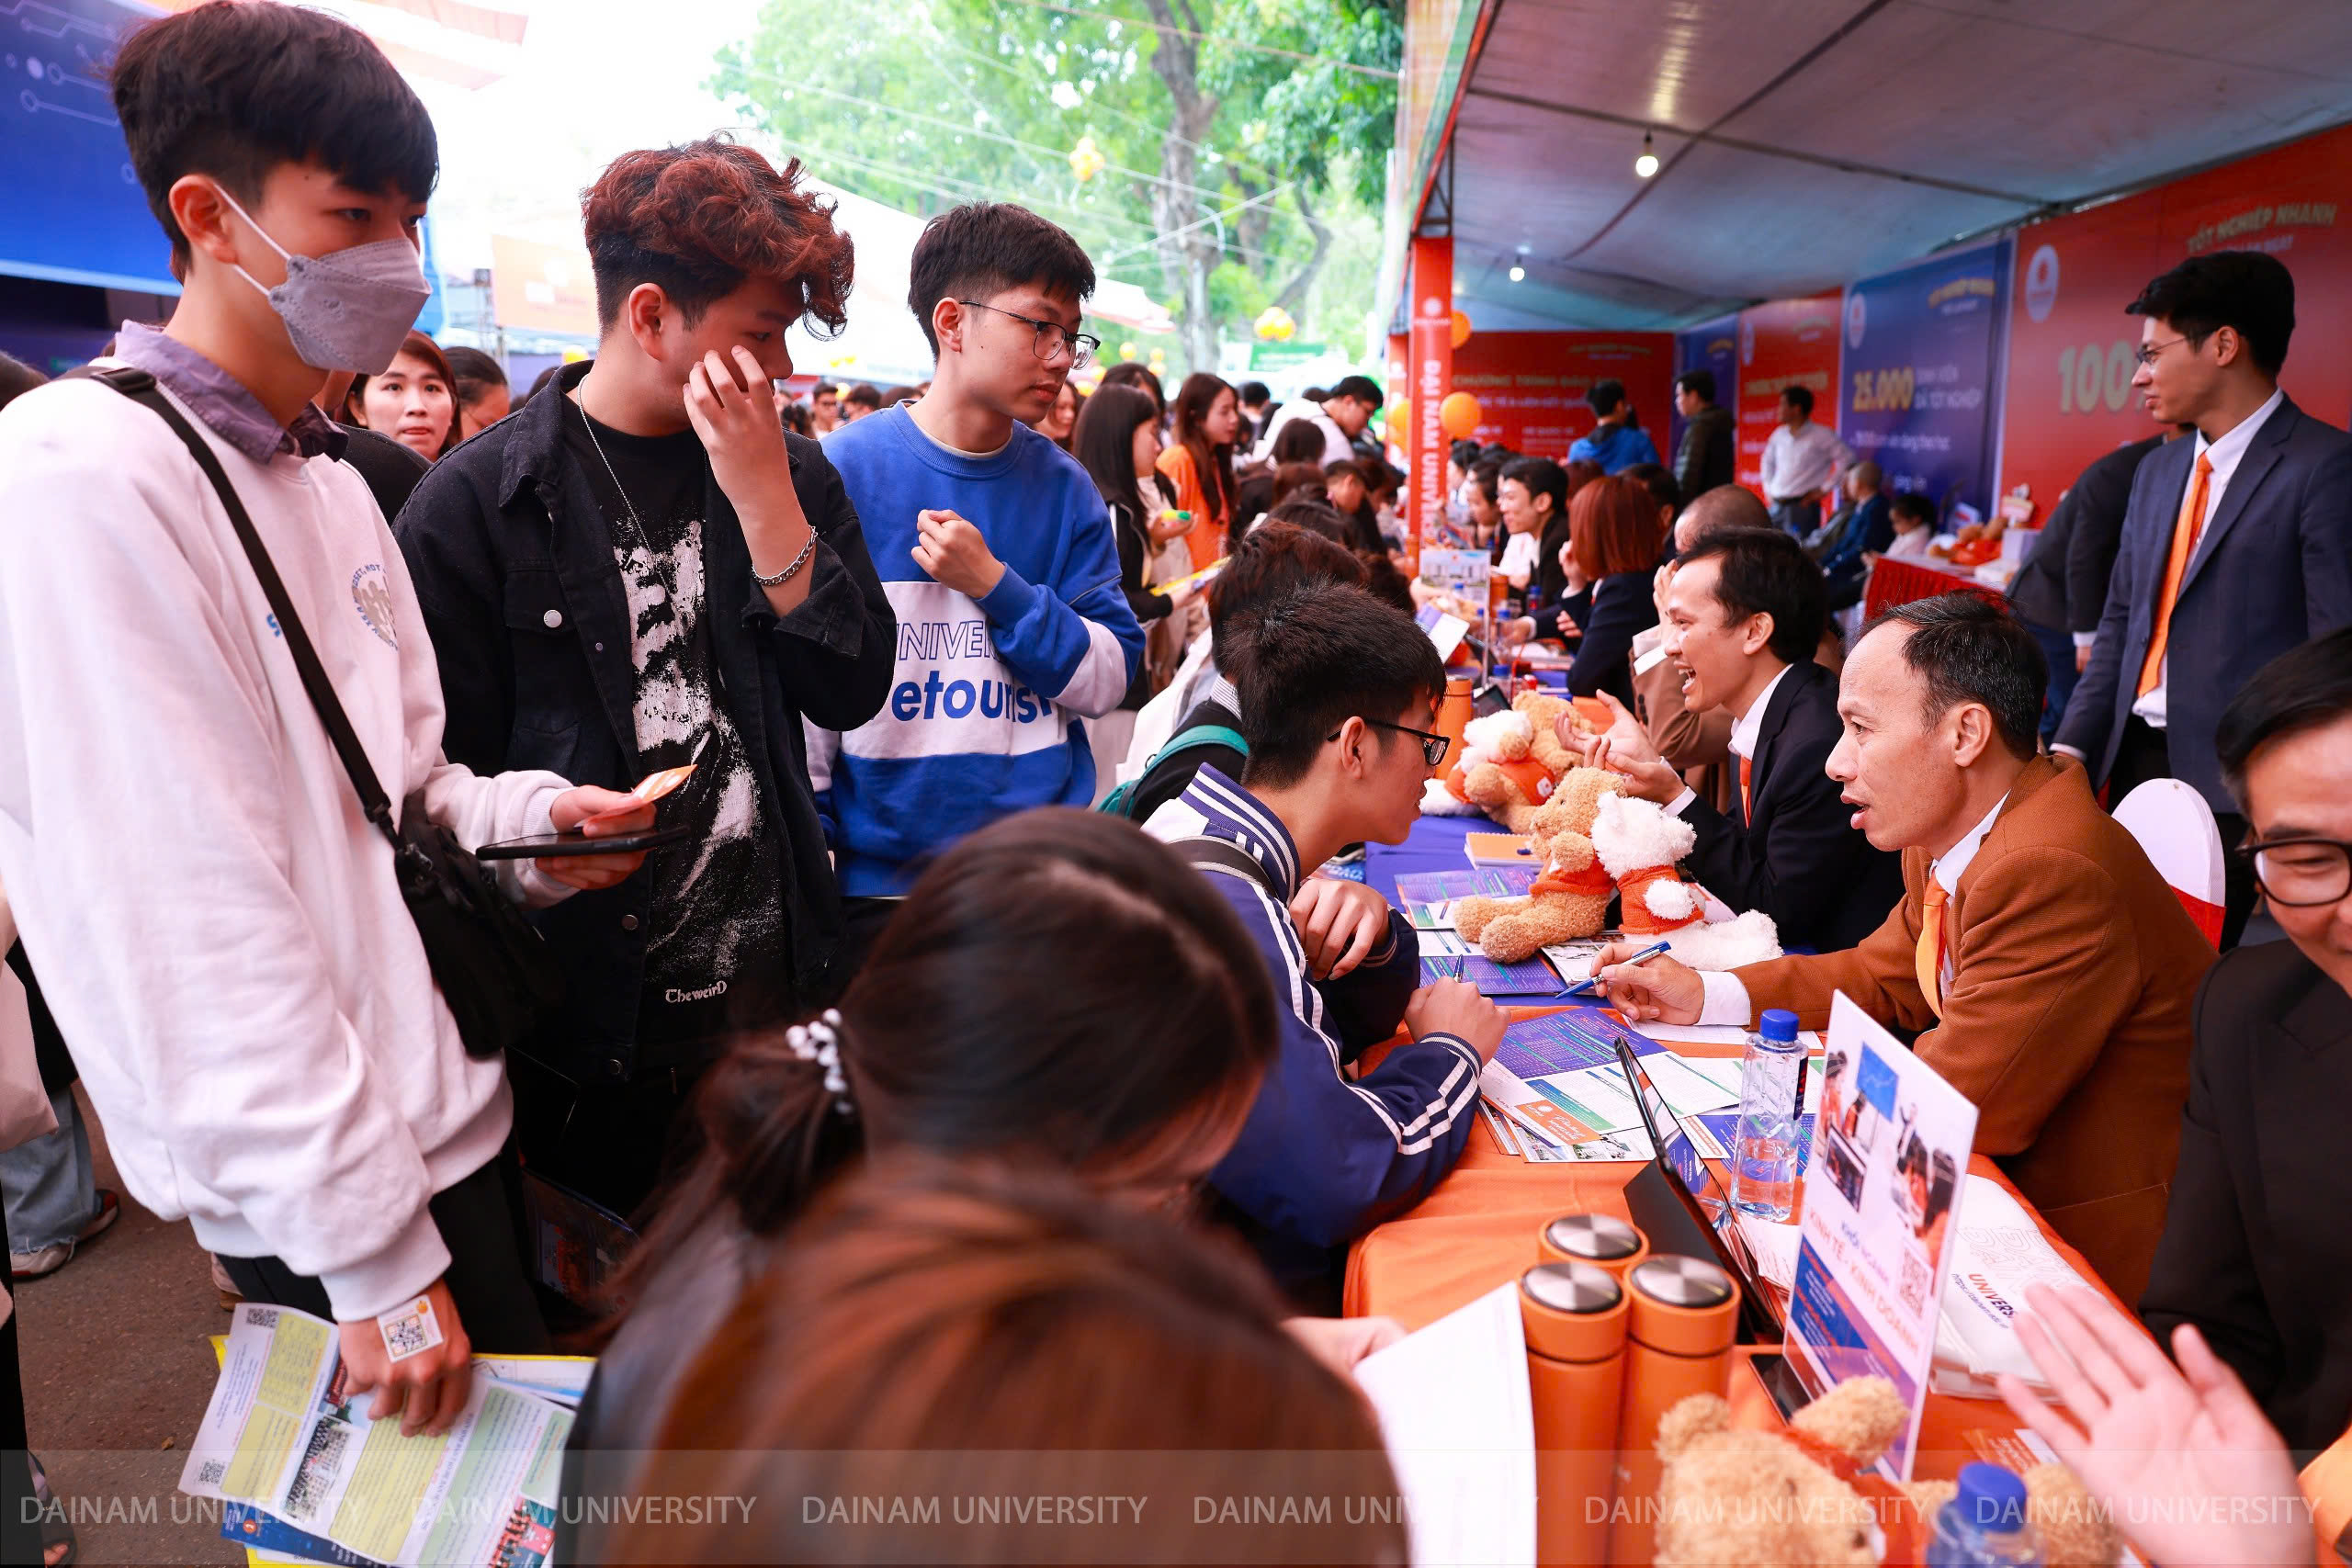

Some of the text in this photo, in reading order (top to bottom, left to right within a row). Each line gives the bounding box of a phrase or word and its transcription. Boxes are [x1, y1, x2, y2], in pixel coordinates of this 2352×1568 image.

[1853, 367, 1915, 412] 25.000
[2058, 340, 2147, 413] 100
[896, 620, 1000, 660] NIVE
